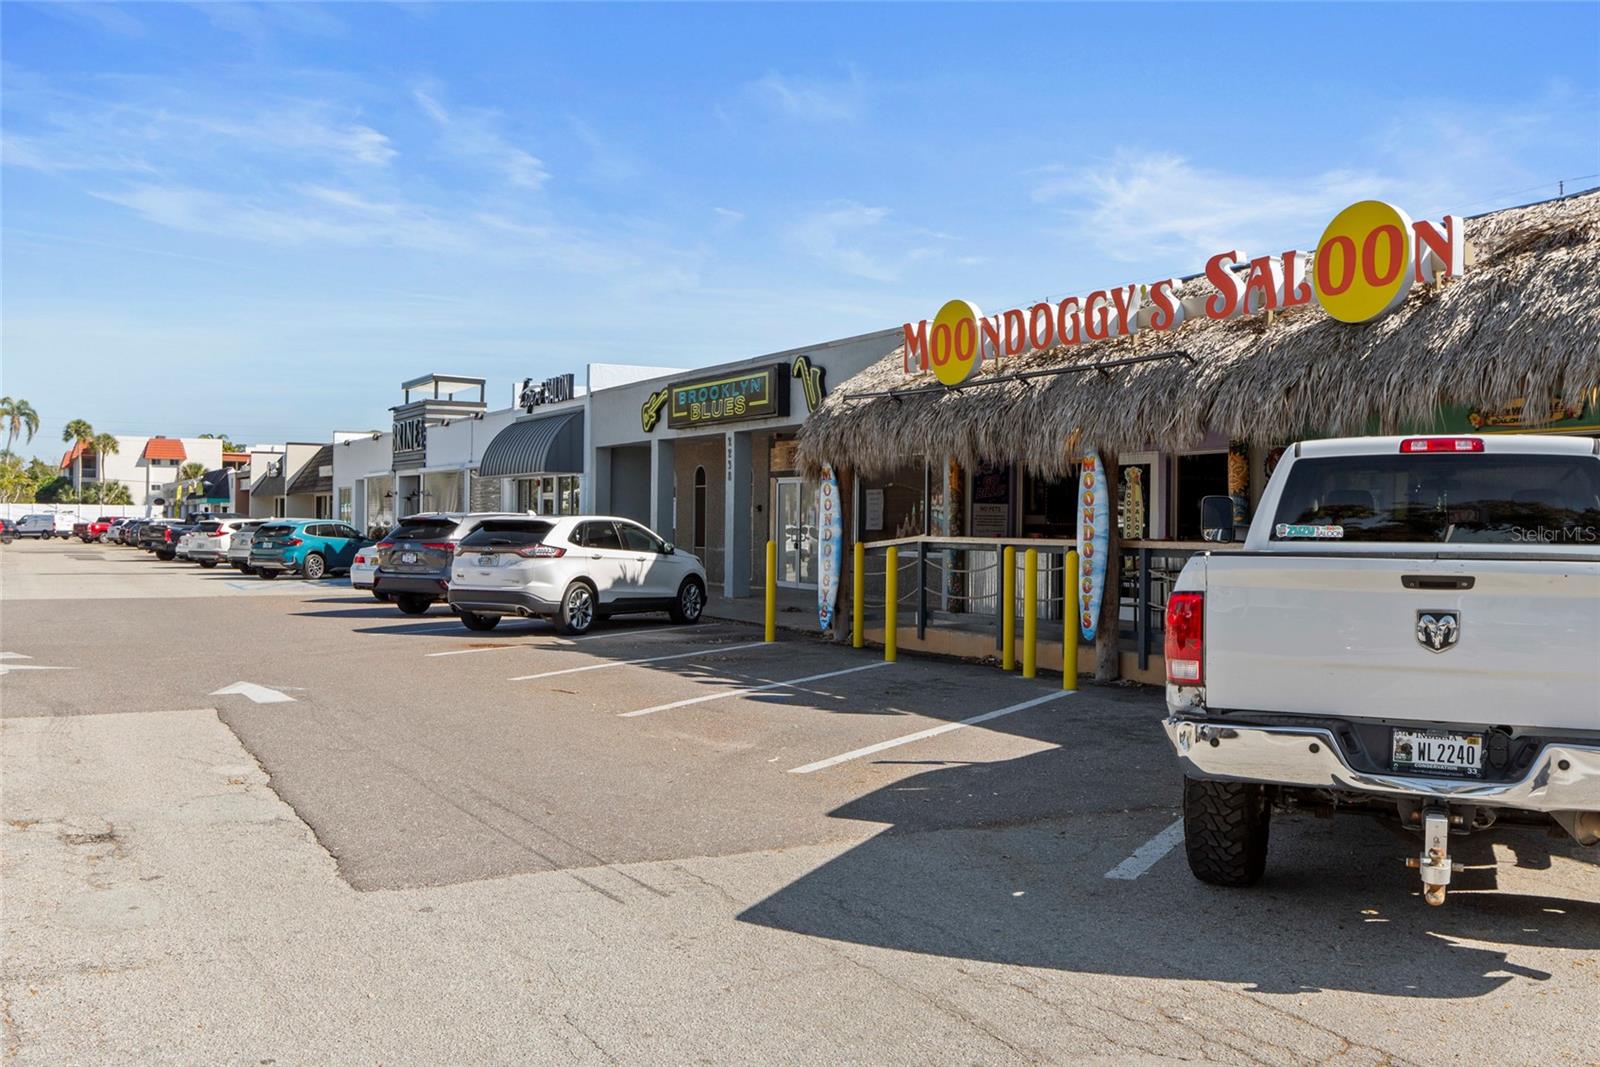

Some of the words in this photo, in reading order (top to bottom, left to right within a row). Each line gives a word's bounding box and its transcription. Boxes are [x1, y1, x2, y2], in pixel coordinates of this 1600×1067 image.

[903, 279, 1177, 374] MOONDOGGY'S
[1205, 215, 1457, 321] SALOON
[545, 373, 573, 404] SALON
[678, 378, 761, 405] BROOKLYN
[690, 395, 746, 420] BLUES
[1417, 742, 1475, 765] WL2240
